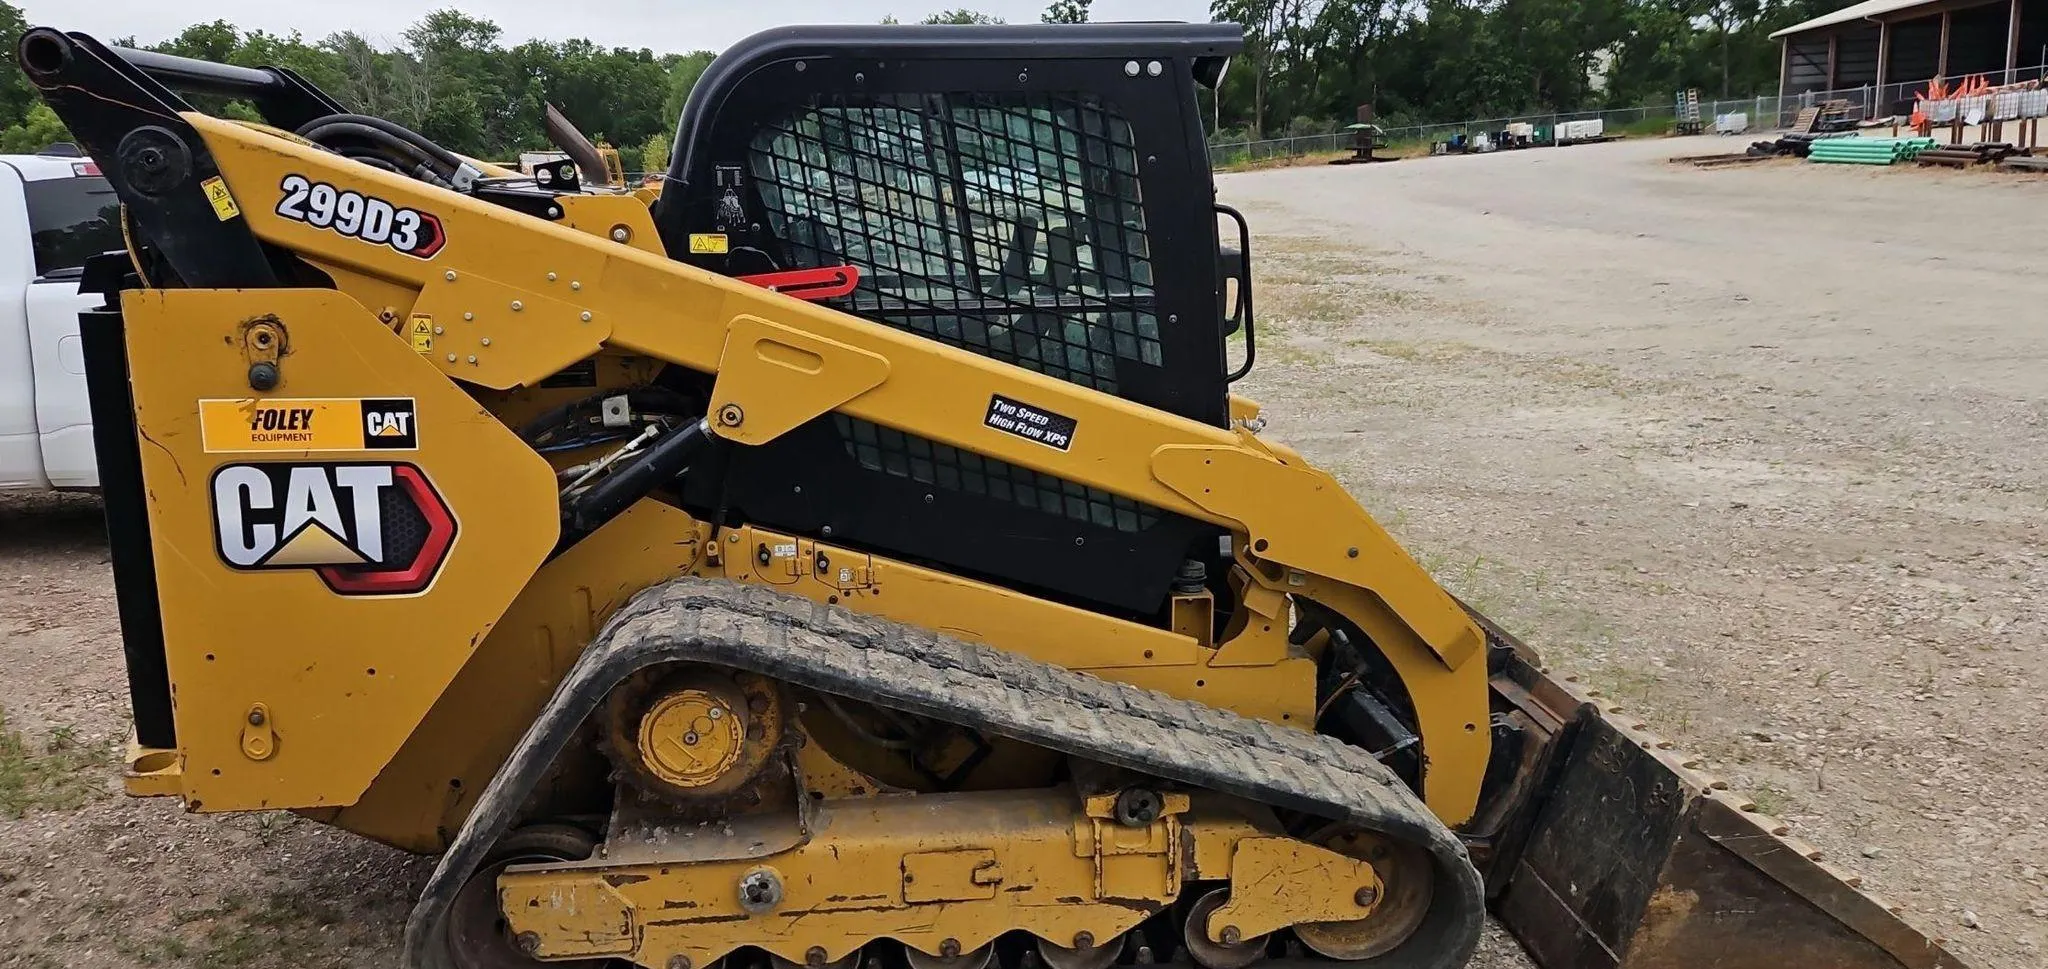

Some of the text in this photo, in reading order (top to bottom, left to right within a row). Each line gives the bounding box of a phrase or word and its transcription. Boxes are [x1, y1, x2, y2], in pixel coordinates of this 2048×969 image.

[278, 176, 421, 251] 299D3
[251, 408, 314, 431] FOLEY
[366, 411, 411, 436] CAT
[251, 432, 314, 442] EQUIPMENT
[1043, 431, 1067, 446] XPS
[215, 465, 393, 566] CAT
